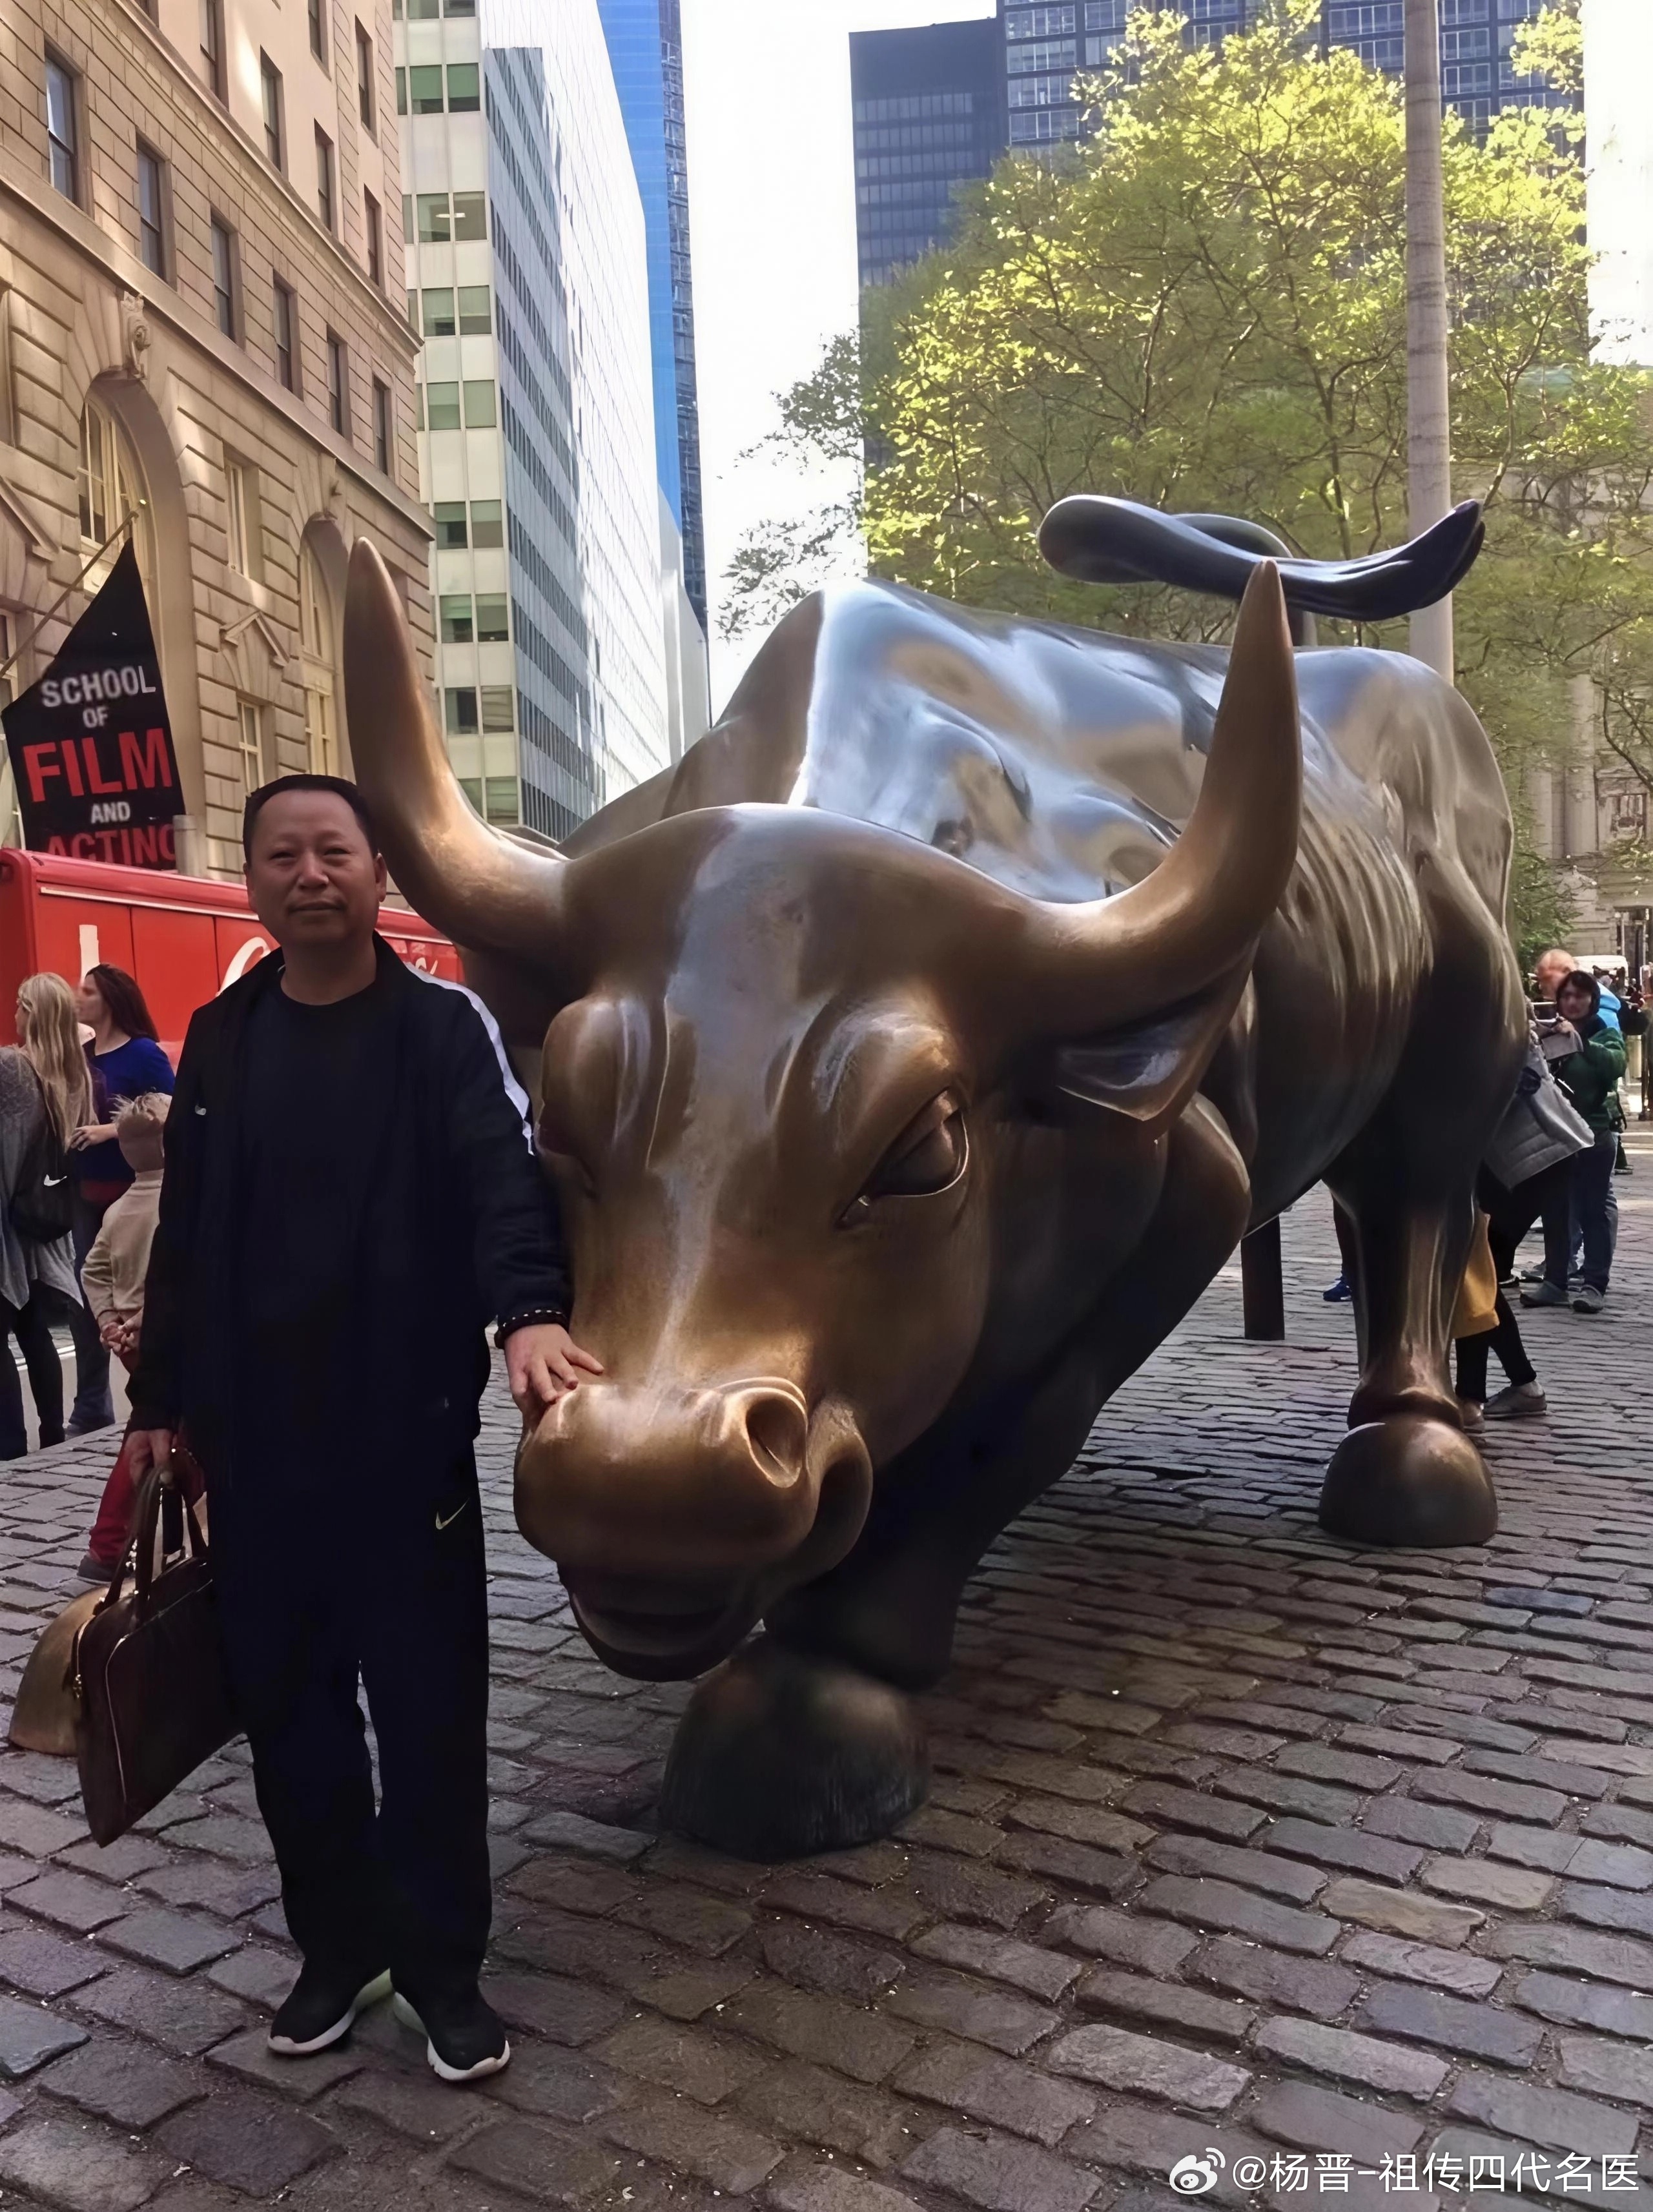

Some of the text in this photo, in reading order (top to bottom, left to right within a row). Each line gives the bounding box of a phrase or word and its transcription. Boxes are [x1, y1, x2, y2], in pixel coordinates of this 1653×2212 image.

[41, 665, 156, 707] SCHOOL
[82, 706, 108, 728] OF
[23, 728, 172, 803] FILM
[90, 801, 130, 824] AND
